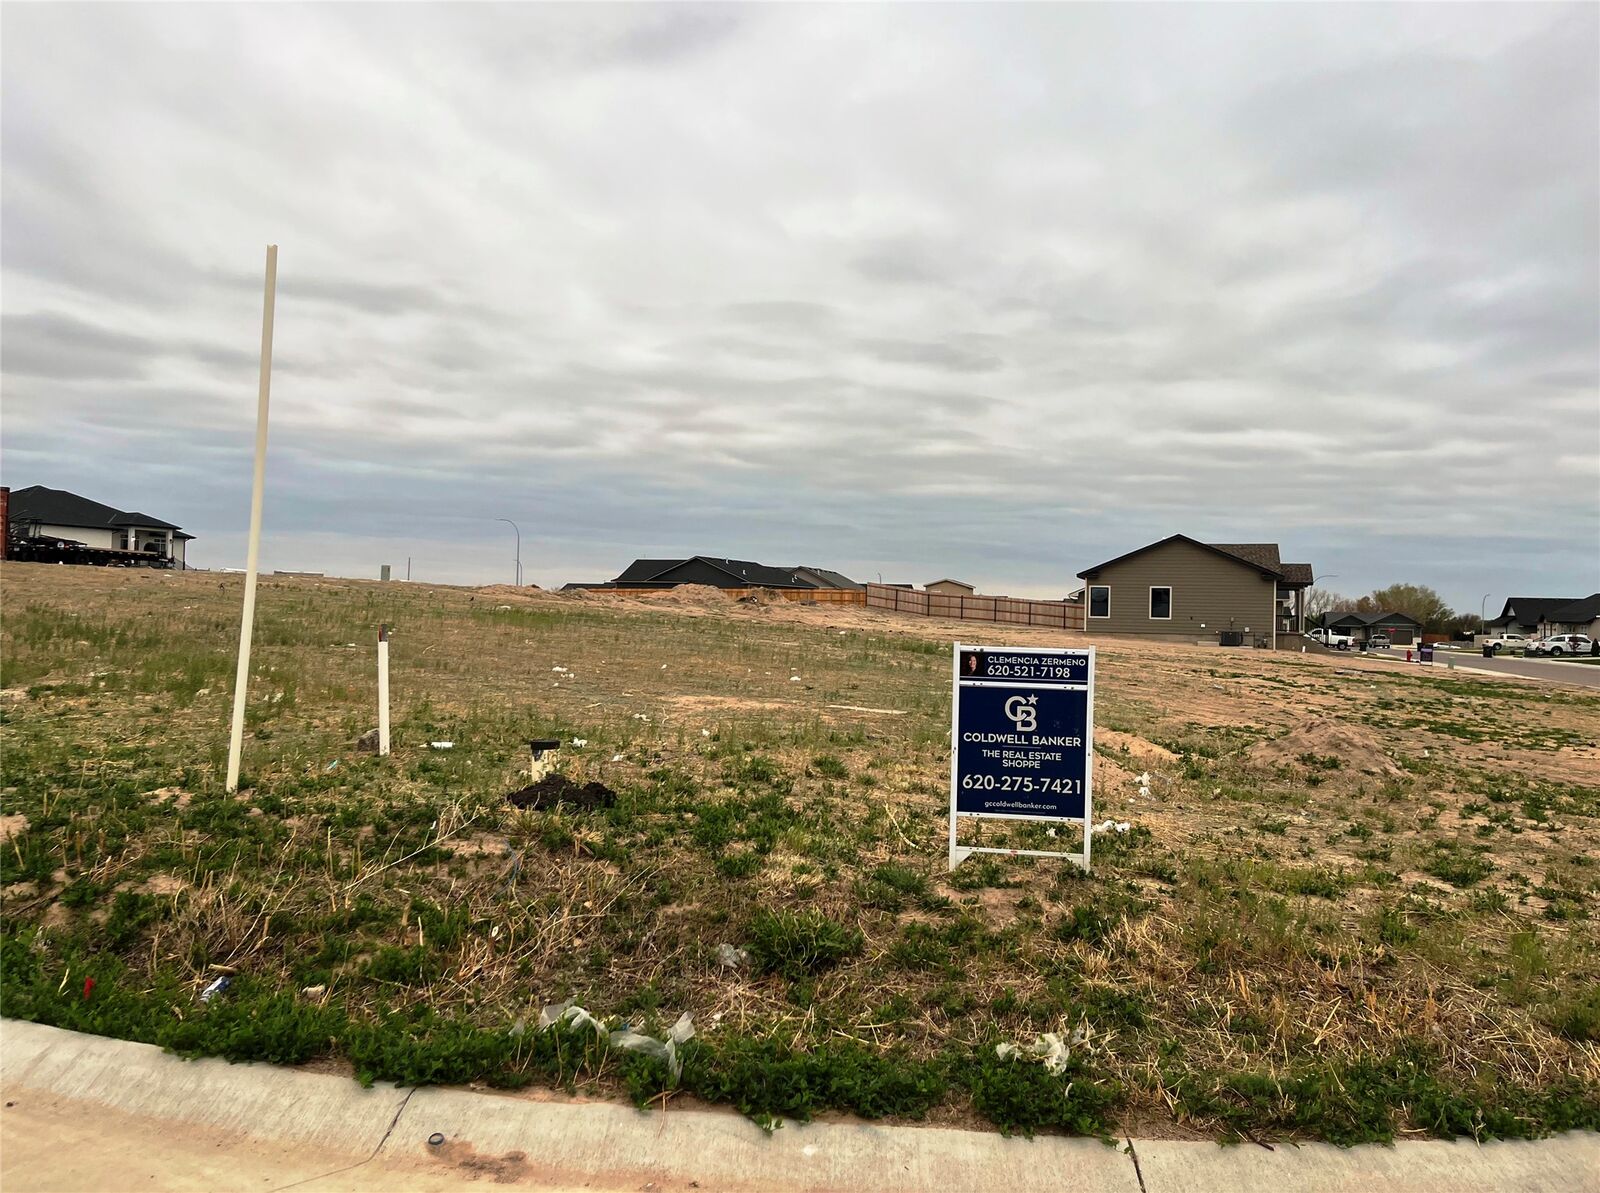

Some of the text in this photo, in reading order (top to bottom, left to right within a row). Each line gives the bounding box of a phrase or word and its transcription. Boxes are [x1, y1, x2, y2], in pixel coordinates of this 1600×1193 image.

[987, 655, 1086, 667] CLEMENCIA ZERMENO
[987, 665, 1071, 678] 620-521-7198
[963, 732, 1081, 747] COLDWELL BANKER
[982, 749, 1062, 761] THE REAL ESTATE
[1002, 759, 1041, 769] SHOPPE
[962, 774, 1081, 795] 620-275-7421
[984, 800, 1057, 811] gccoldwellbanker.com
